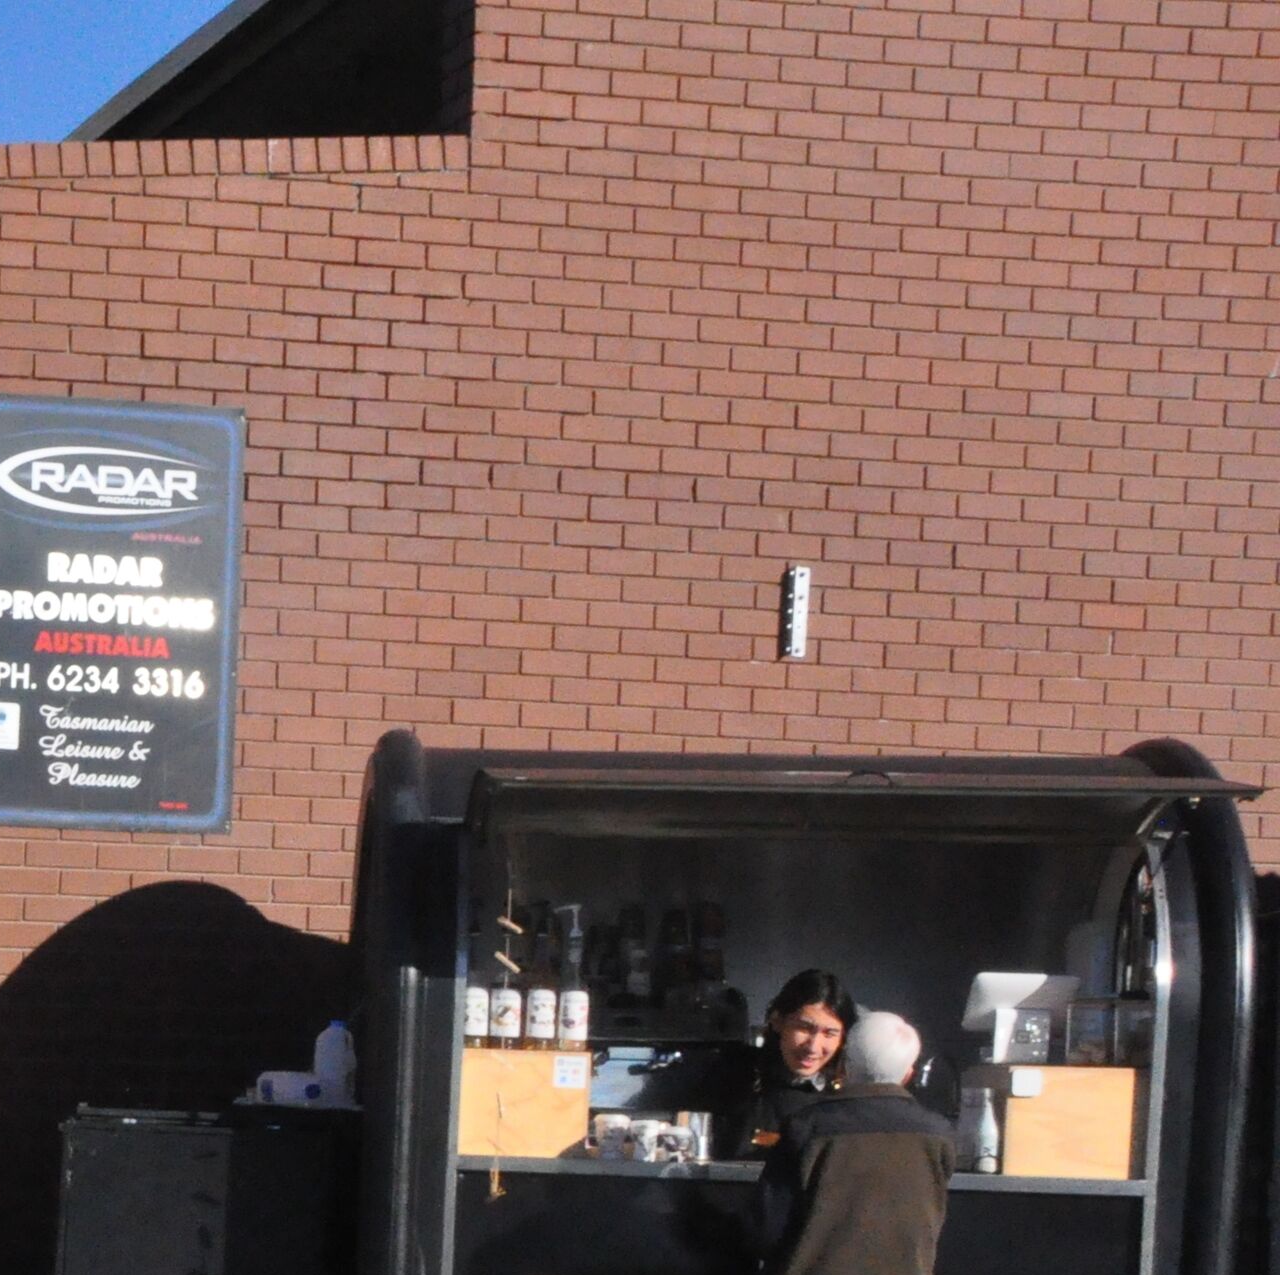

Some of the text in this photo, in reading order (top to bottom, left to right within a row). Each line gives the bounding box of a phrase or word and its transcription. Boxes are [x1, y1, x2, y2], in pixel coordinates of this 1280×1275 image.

[31, 461, 198, 501] RADAR
[47, 552, 163, 588] RADAR
[47, 664, 120, 694] 6234
[132, 667, 205, 699] 3316
[39, 704, 154, 734] Tasmanian
[39, 734, 124, 761] Leisure
[128, 737, 151, 761] &
[48, 762, 141, 790] Pleasure
